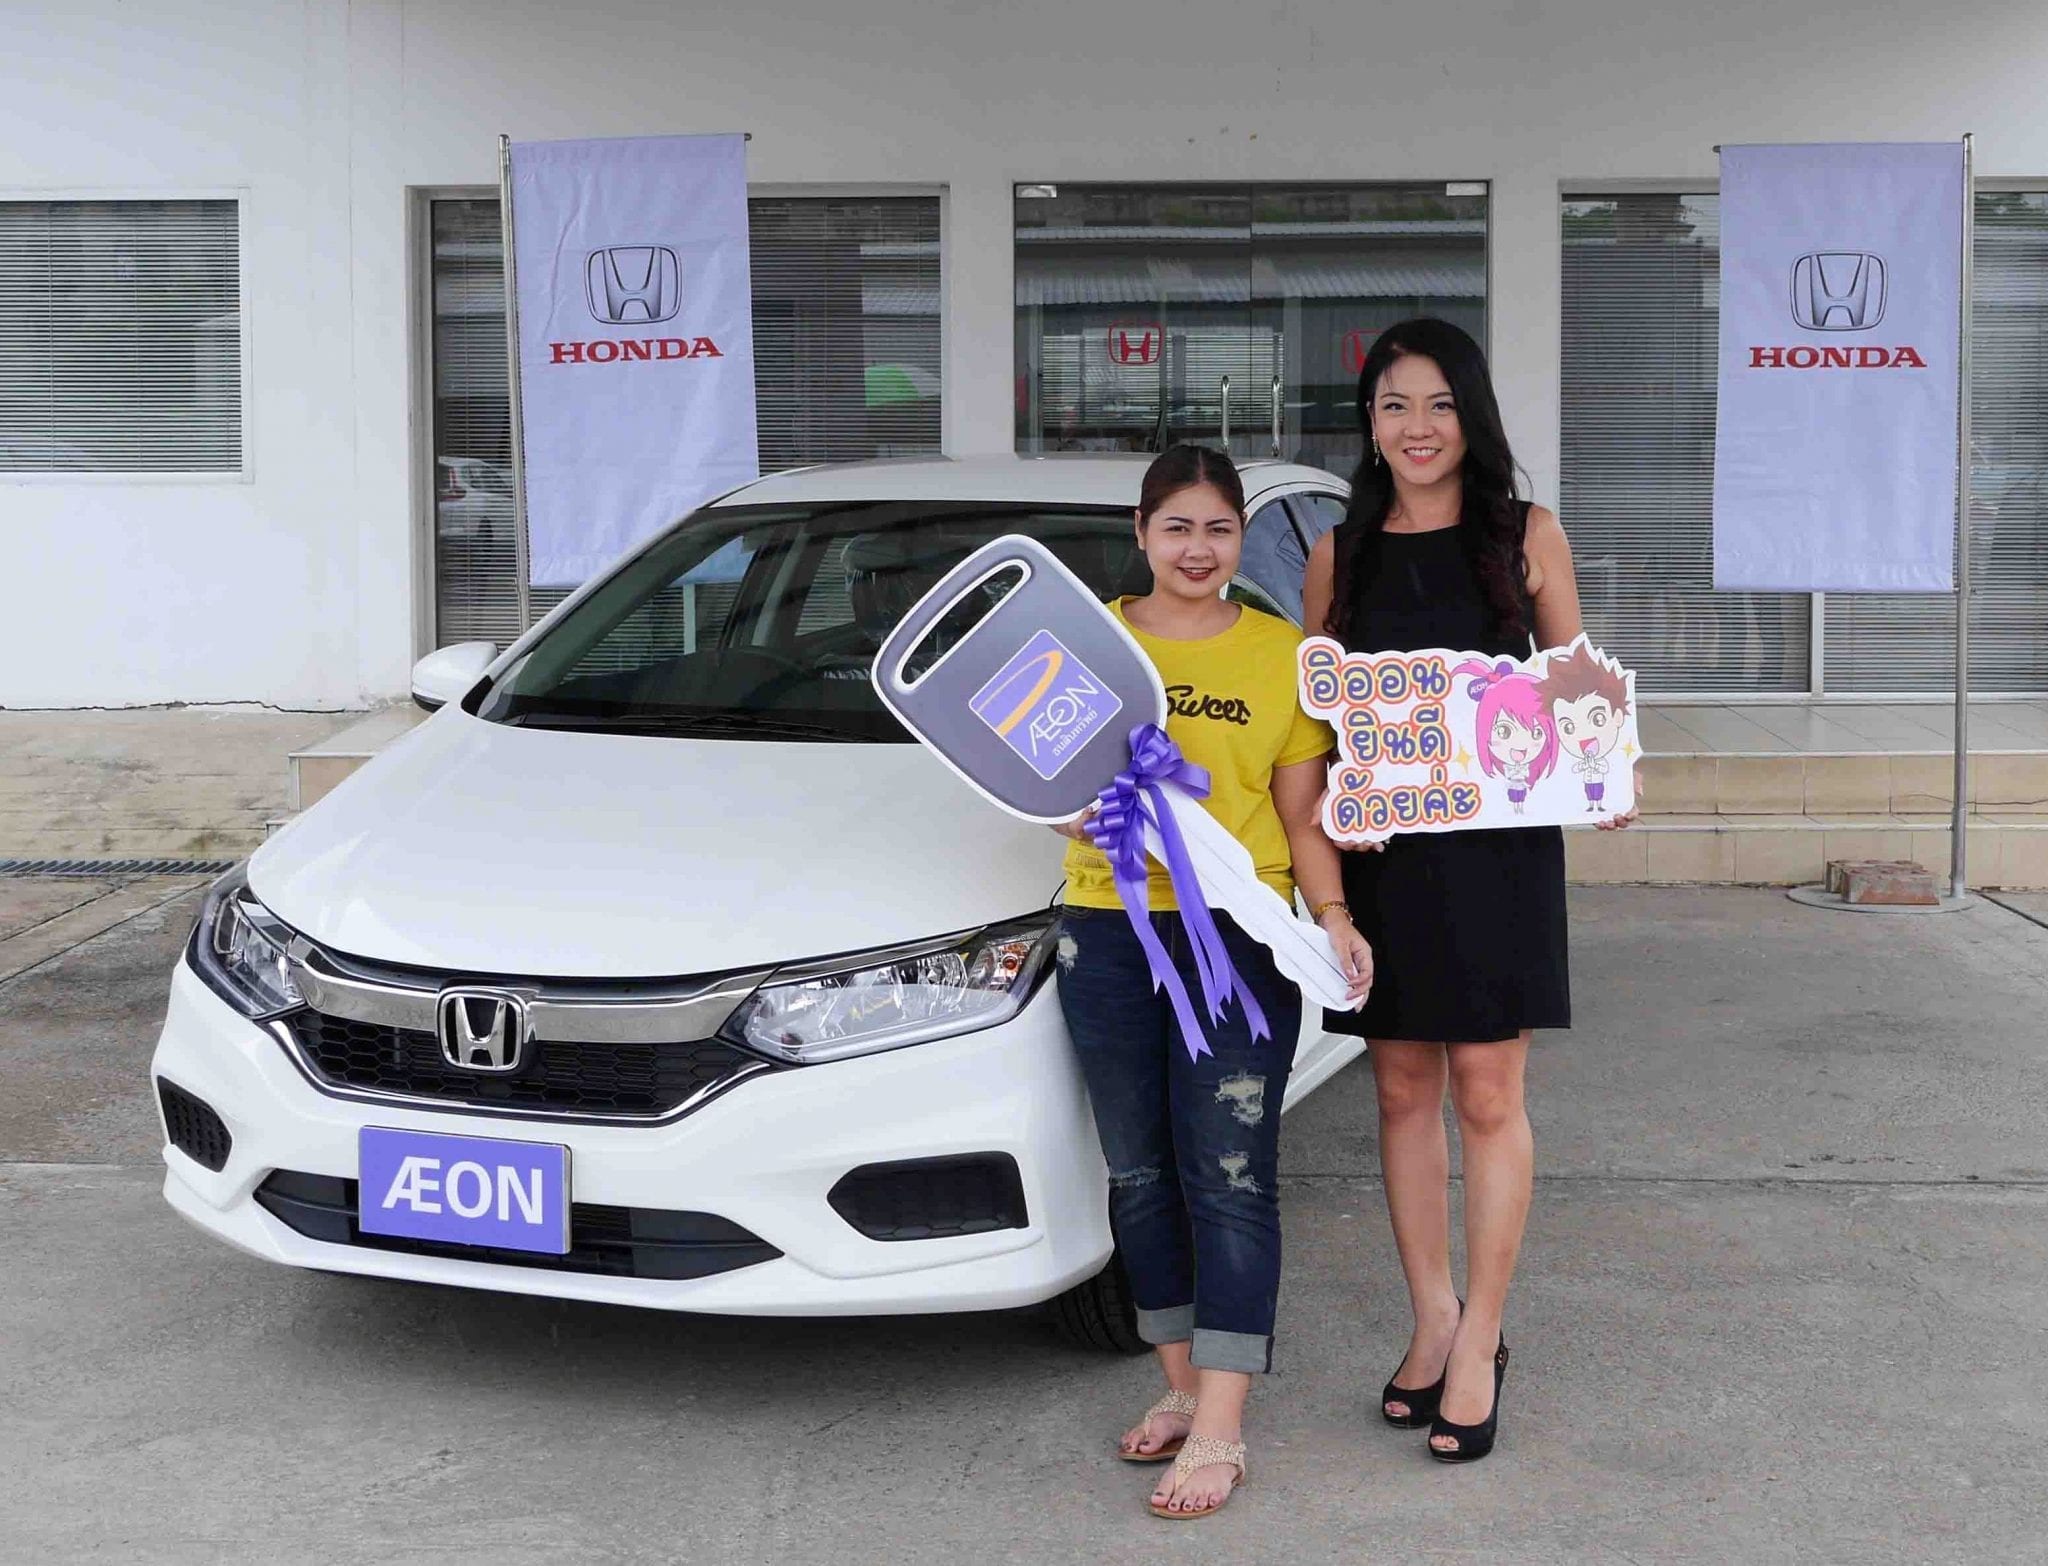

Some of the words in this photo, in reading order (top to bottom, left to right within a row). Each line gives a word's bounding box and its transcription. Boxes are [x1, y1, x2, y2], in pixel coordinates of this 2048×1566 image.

[549, 336, 724, 365] HONDA
[1749, 346, 1927, 369] HONDA
[1306, 648, 1448, 704] อิออน
[1347, 706, 1448, 763] ยินดี
[1335, 766, 1478, 830] ด้วยค่ะ
